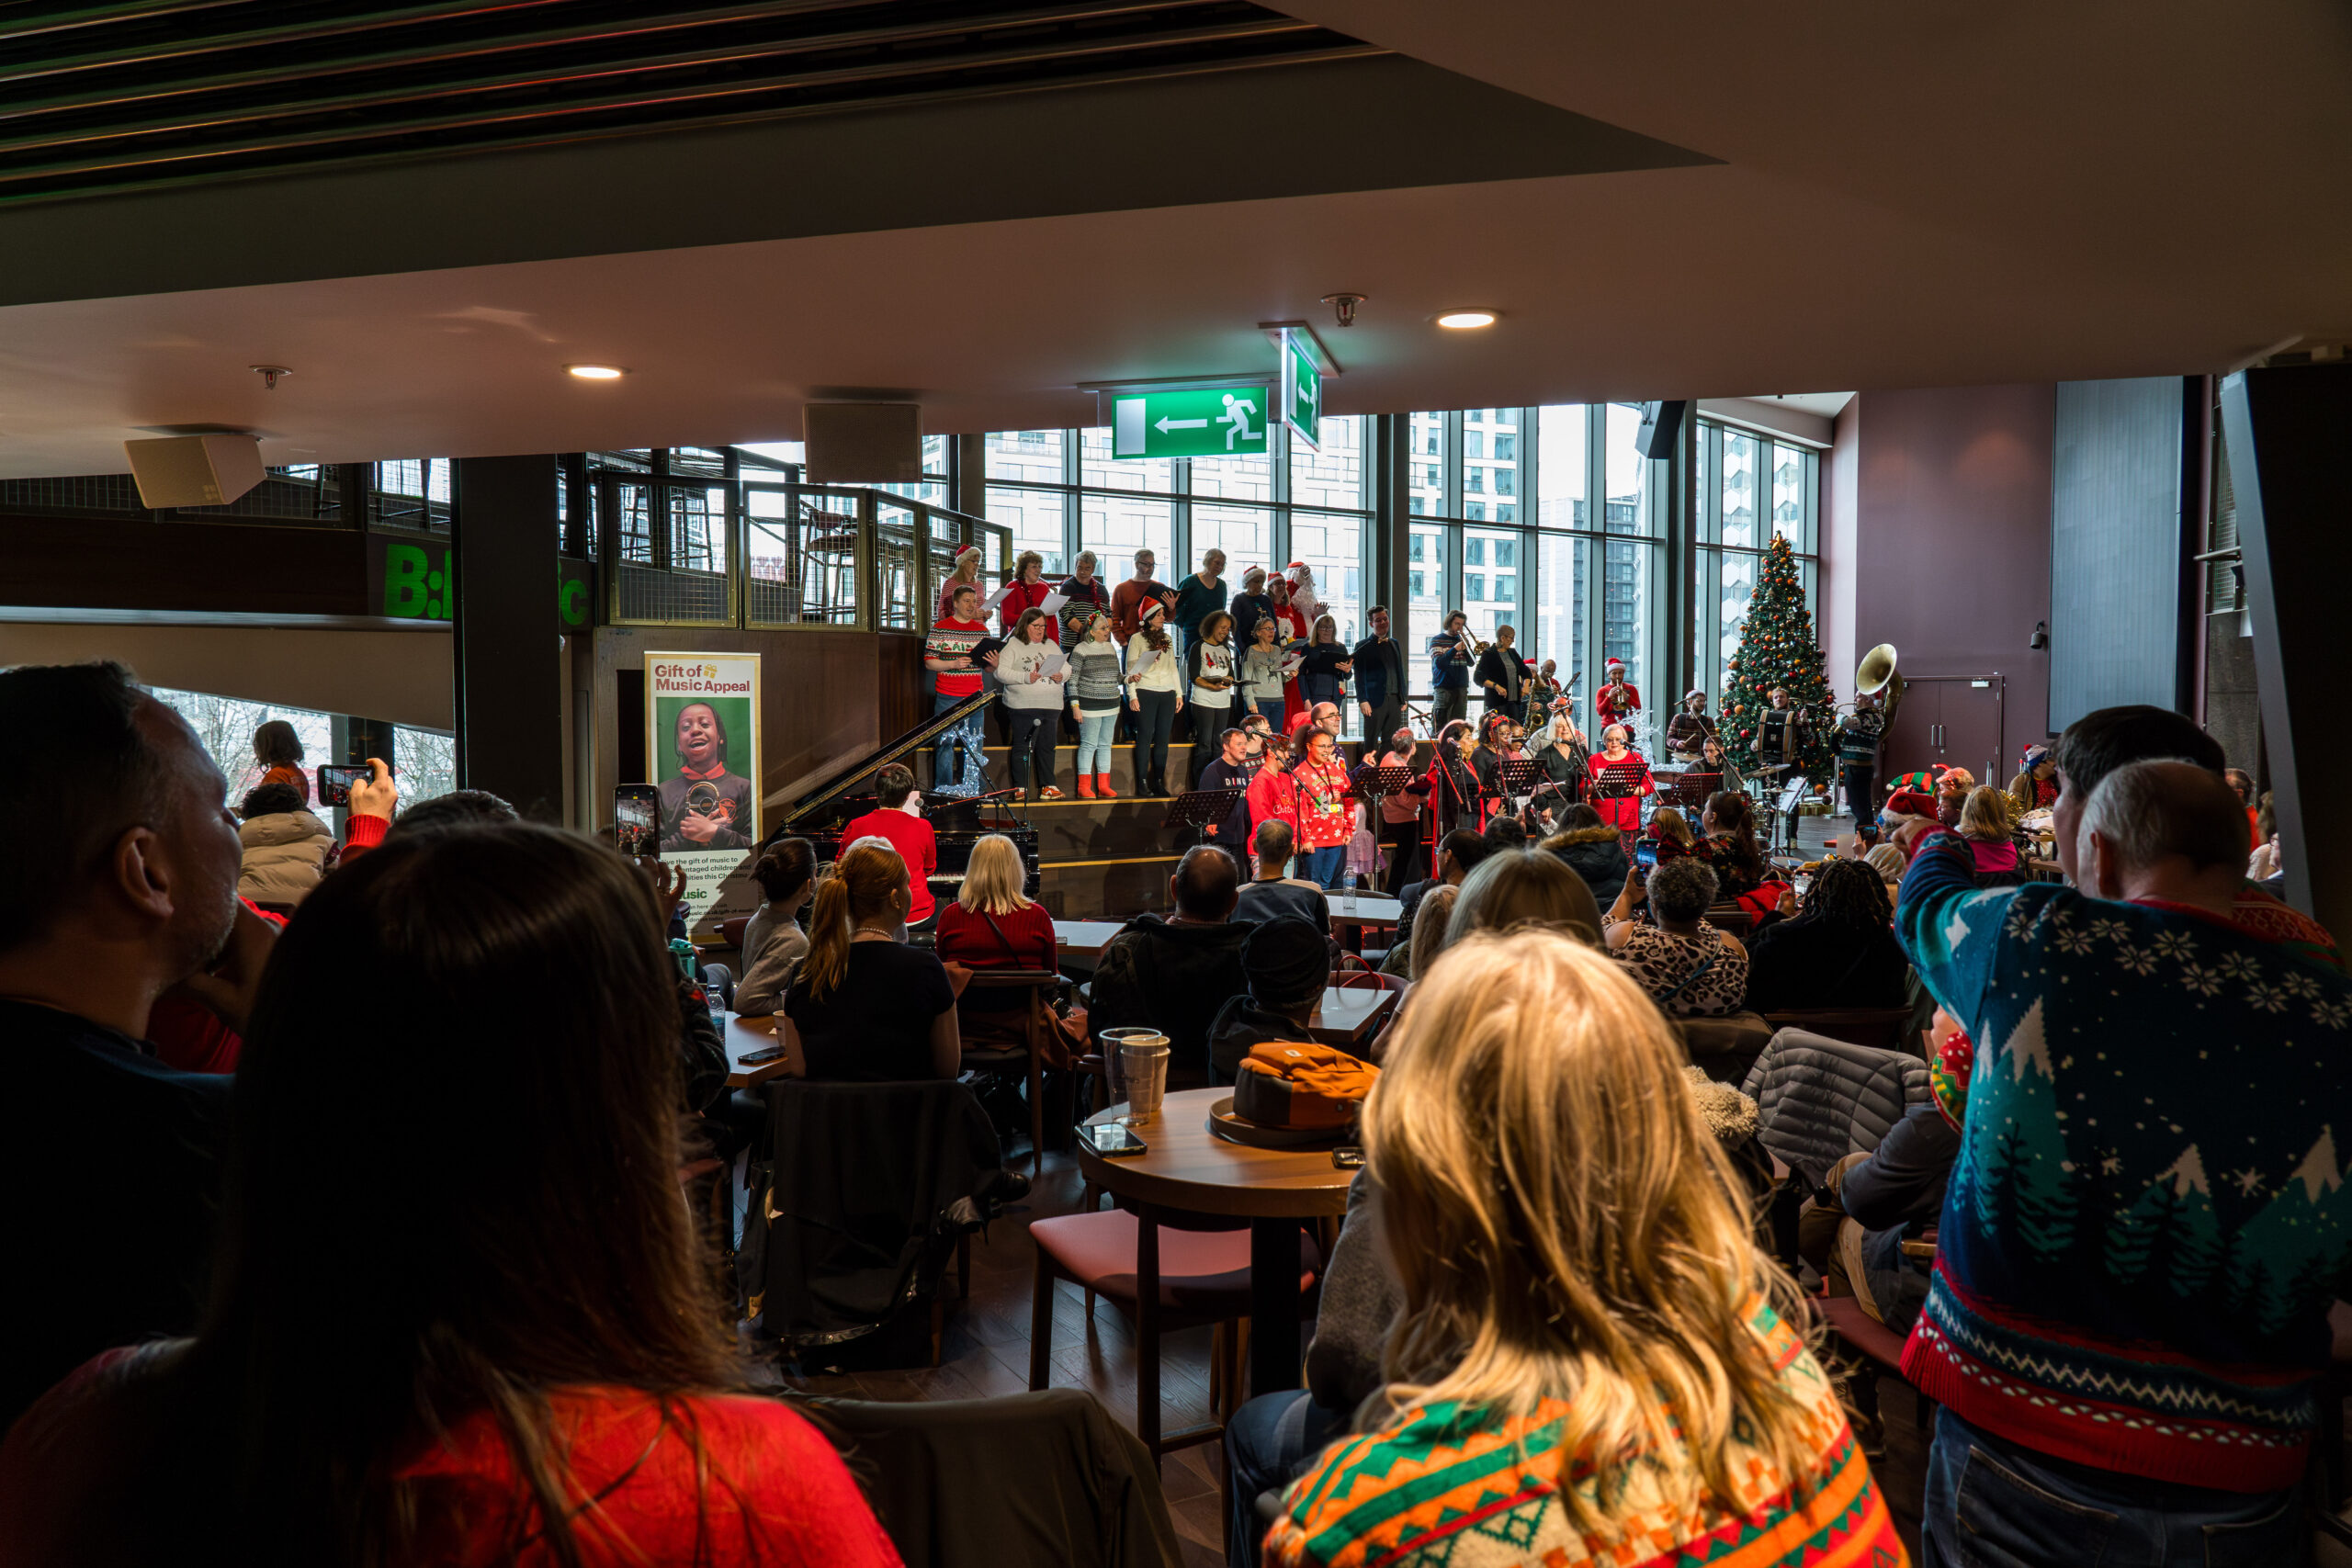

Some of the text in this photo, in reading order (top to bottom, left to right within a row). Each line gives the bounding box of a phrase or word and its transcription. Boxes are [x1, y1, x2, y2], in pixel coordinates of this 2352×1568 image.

[655, 664, 702, 678] Gift of
[656, 678, 751, 694] Music Appeal
[688, 857, 701, 866] gift
[701, 856, 708, 864] of
[710, 863, 737, 872] children
